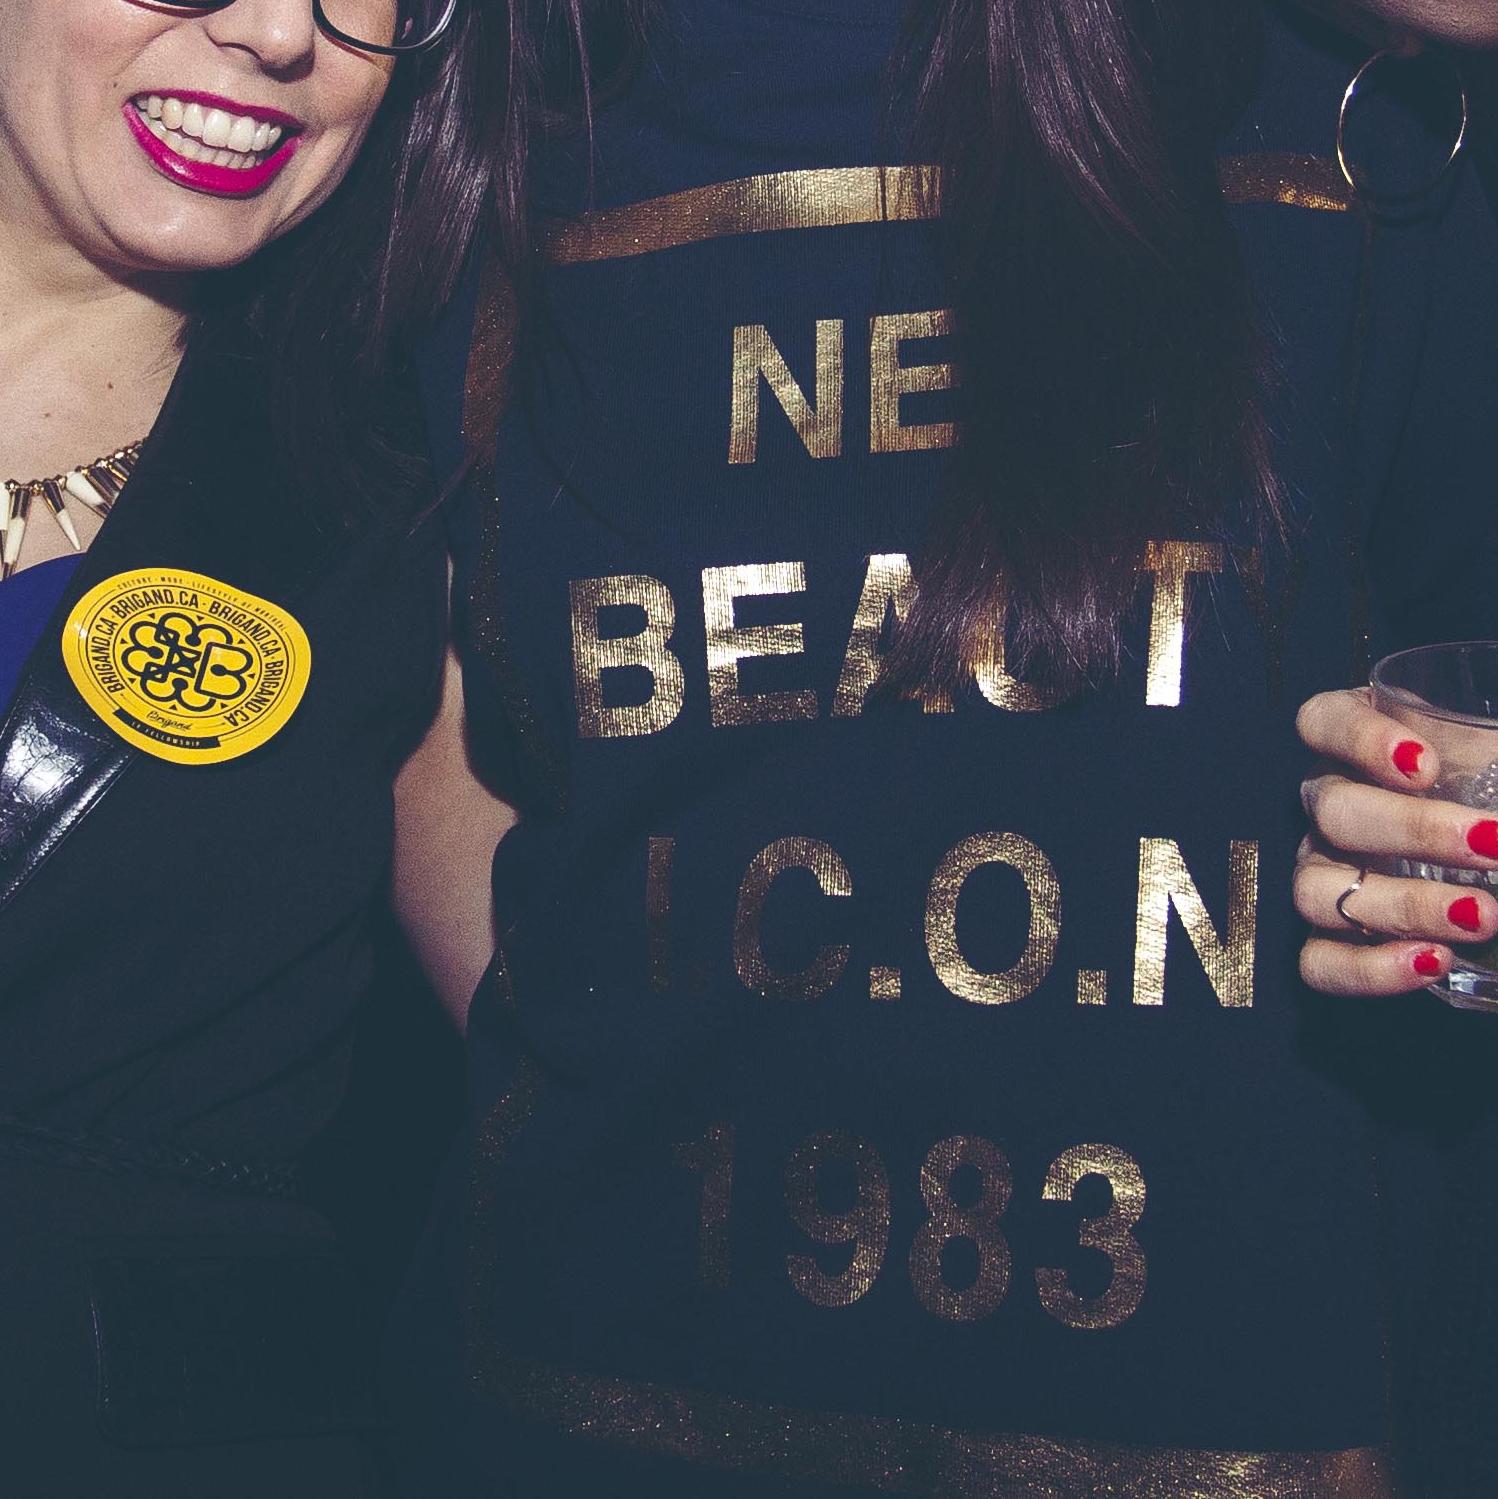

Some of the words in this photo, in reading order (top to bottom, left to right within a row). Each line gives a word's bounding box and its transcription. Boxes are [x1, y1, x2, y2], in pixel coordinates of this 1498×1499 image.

[727, 308, 964, 465] NE
[109, 589, 199, 619] BRIGAND.CA
[208, 600, 282, 658] BRIGAND.CA
[91, 617, 126, 693] BRIGAND.CA
[223, 660, 284, 727] BRIGAND.CA
[671, 1120, 1149, 1330] 1983
